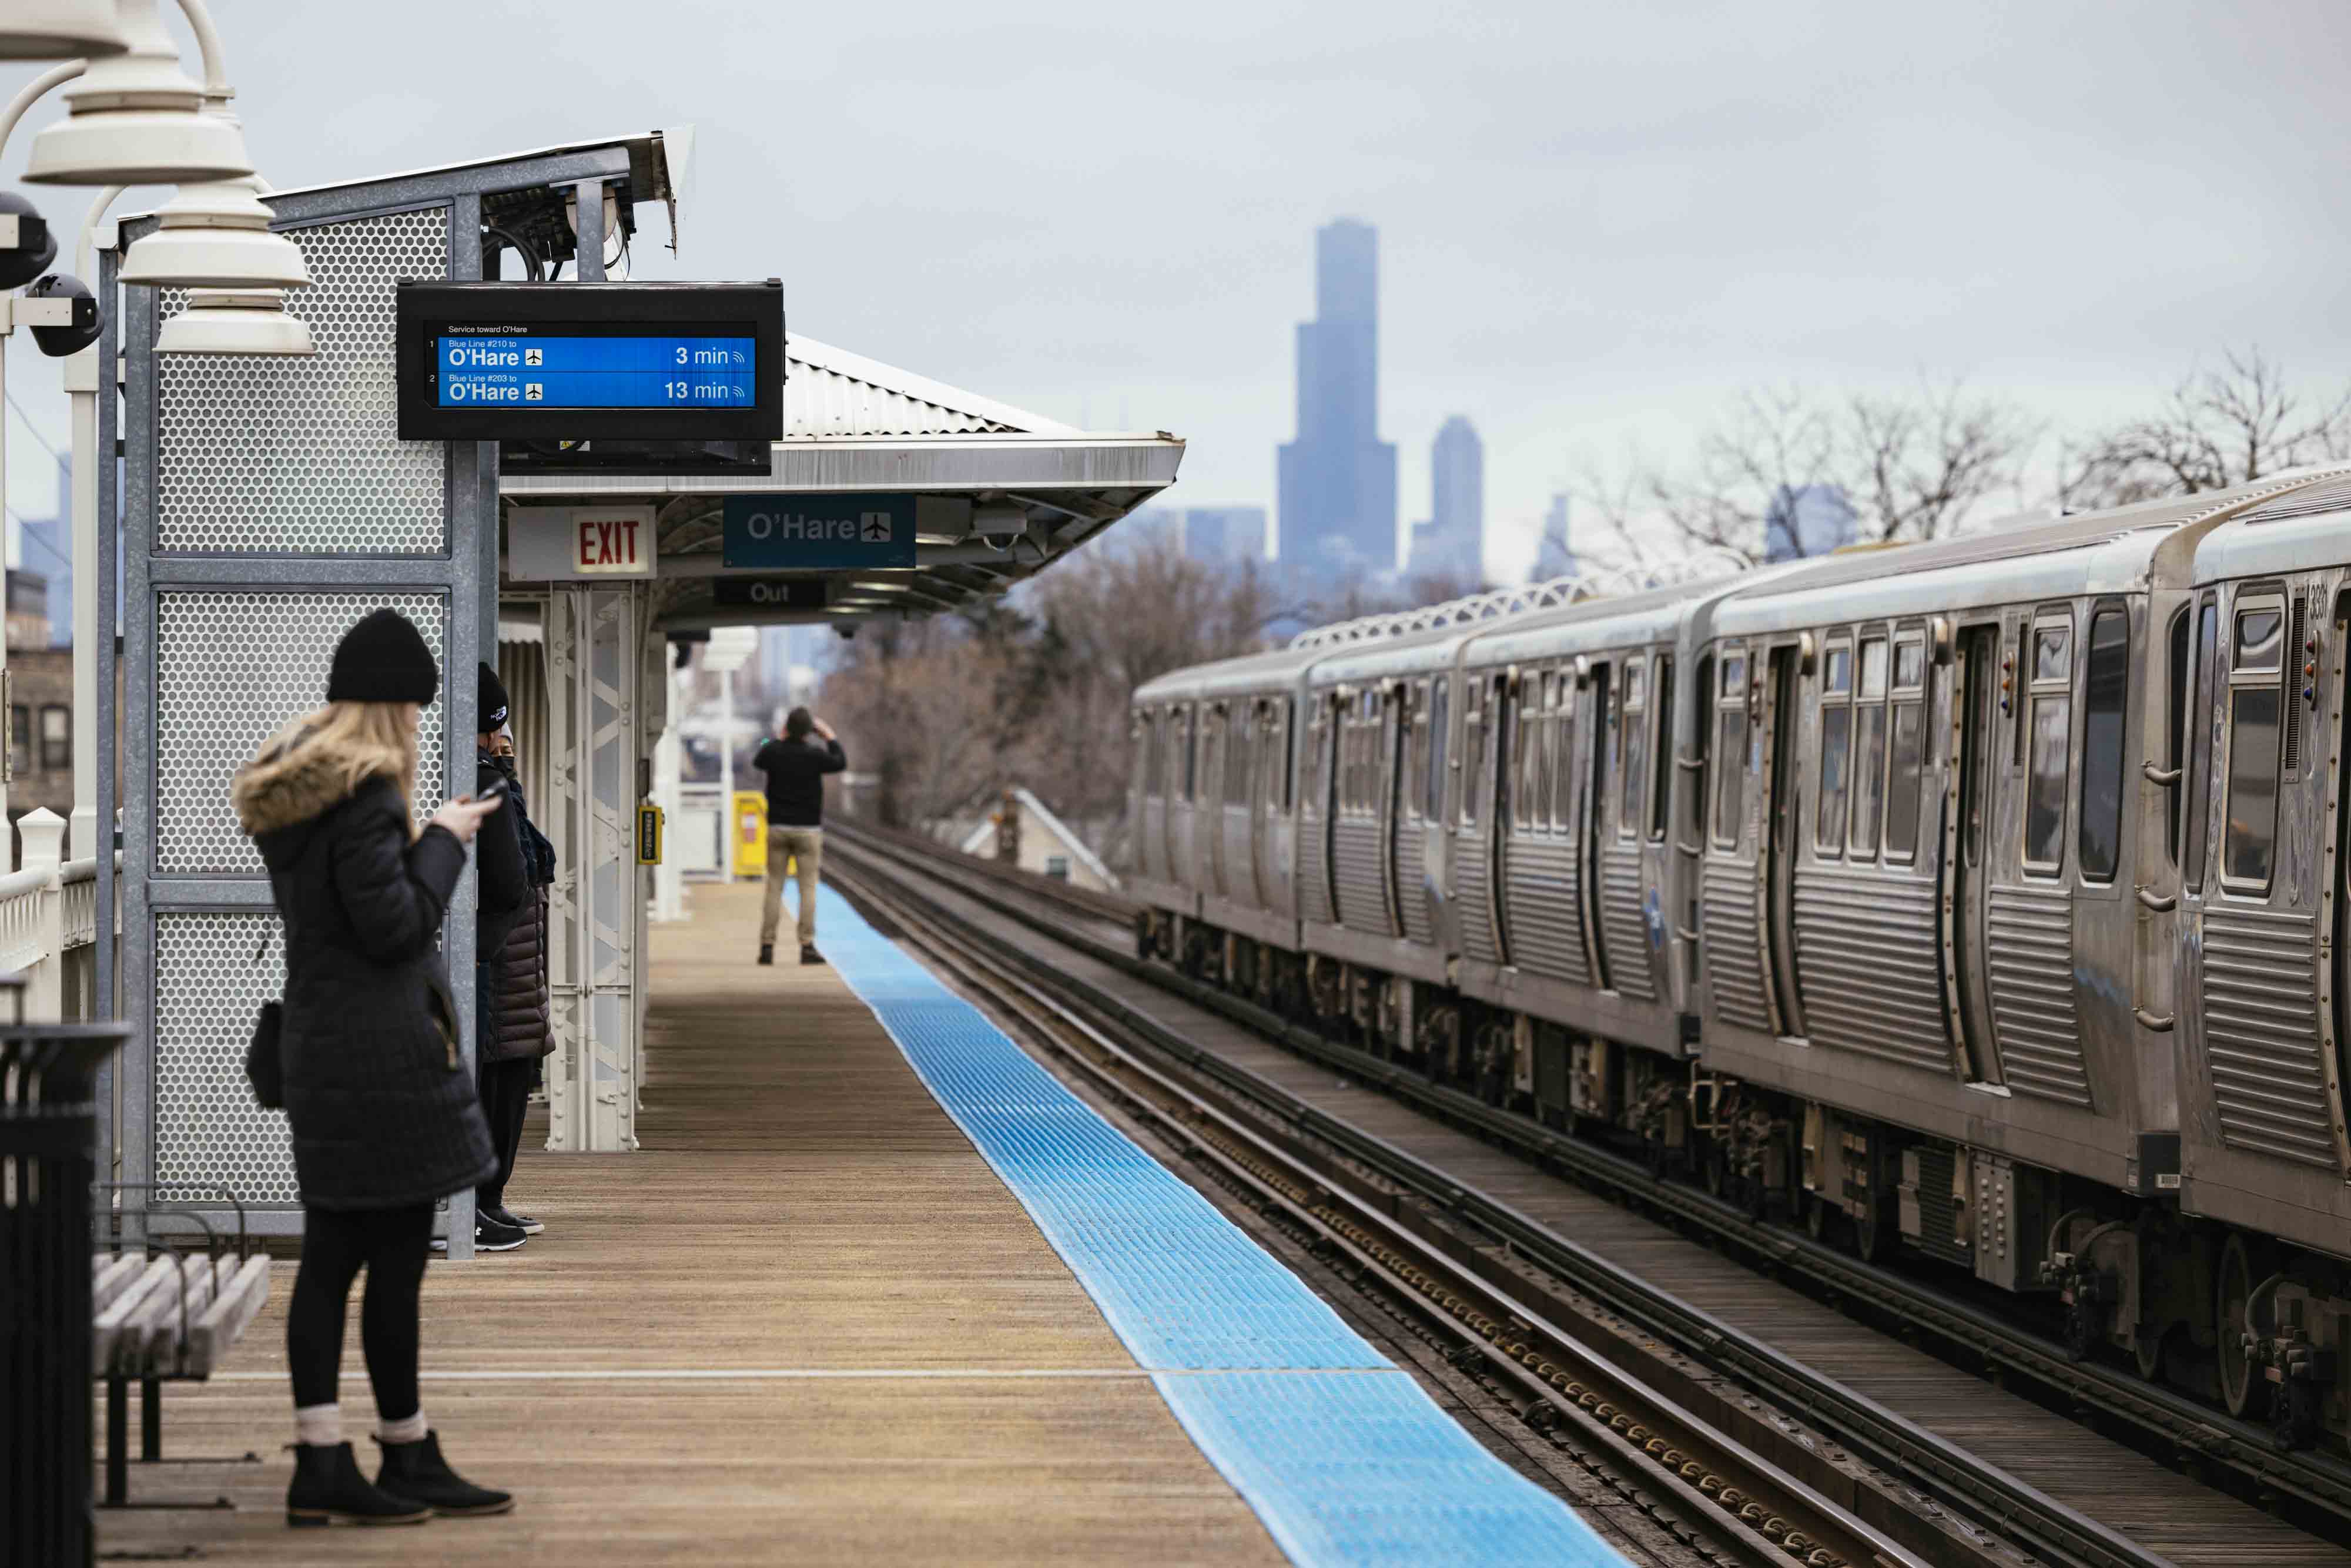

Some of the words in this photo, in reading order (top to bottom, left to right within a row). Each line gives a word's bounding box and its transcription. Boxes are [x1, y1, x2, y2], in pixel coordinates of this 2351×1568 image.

[449, 349, 519, 366] O'Hare
[677, 347, 688, 364] 3
[695, 347, 728, 364] min
[450, 383, 519, 400] O'Hare
[665, 382, 688, 398] 13
[695, 381, 728, 398] min
[748, 513, 856, 540] O'Hare
[580, 521, 639, 565] EXIT
[751, 582, 789, 602] Out
